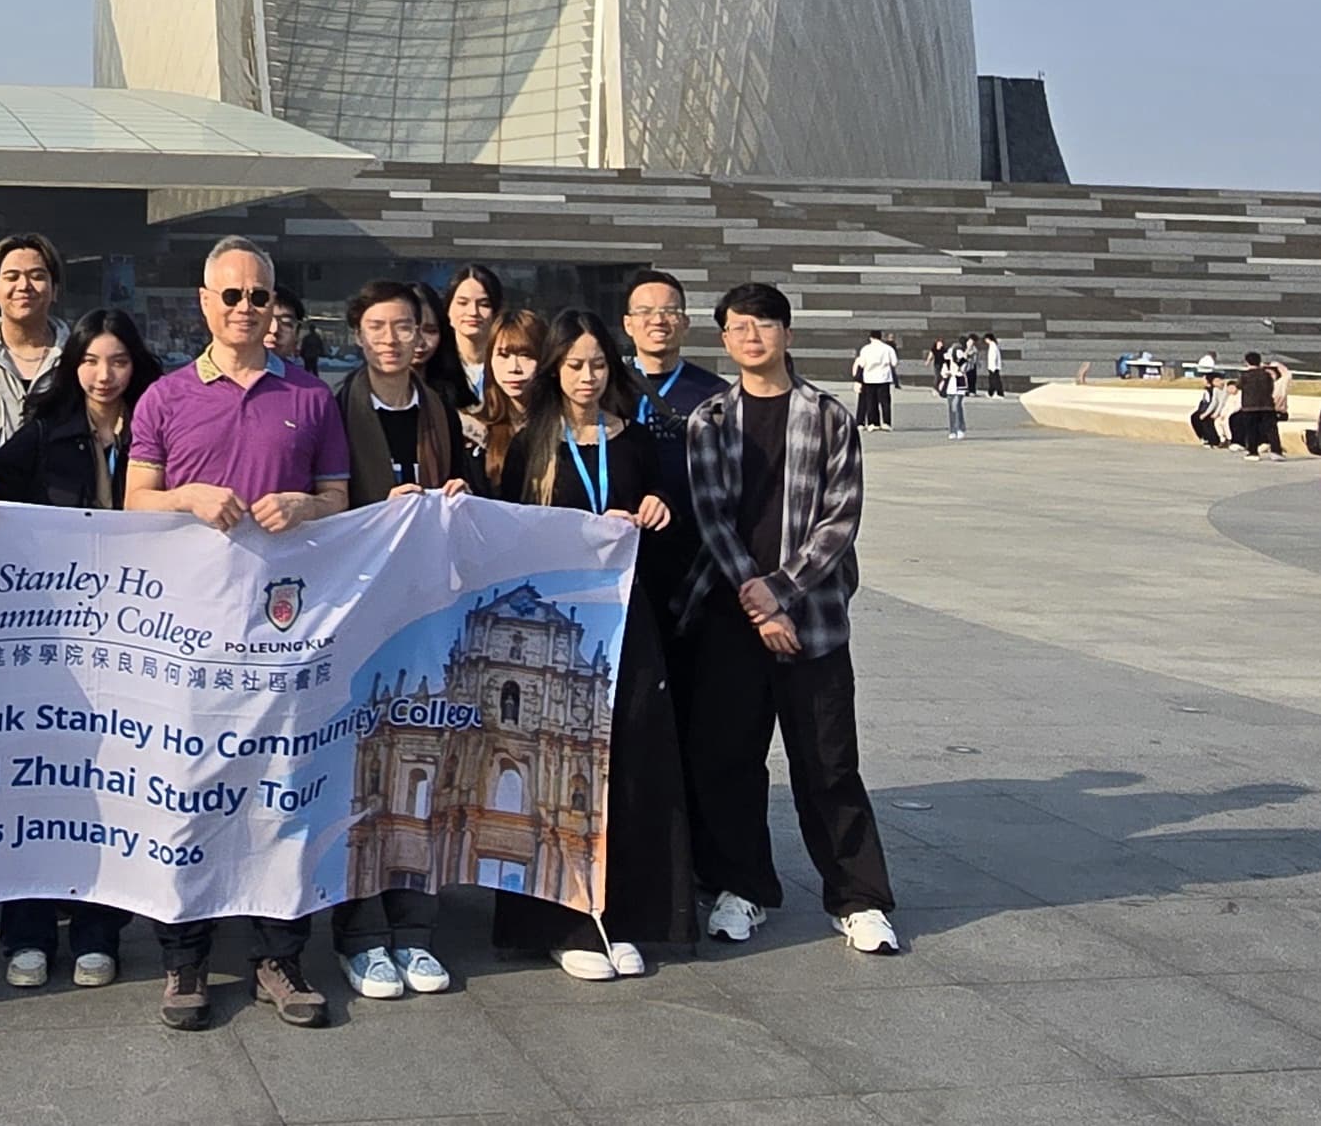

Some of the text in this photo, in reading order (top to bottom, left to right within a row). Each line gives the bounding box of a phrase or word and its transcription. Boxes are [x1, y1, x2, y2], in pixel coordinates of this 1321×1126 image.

[116, 566, 164, 600] Ho
[117, 605, 213, 655] College
[224, 641, 247, 653] PO
[249, 640, 303, 654] LEUNG
[35, 704, 153, 749] Stanley
[163, 724, 205, 756] Ho
[218, 705, 380, 758] Community
[10, 755, 136, 797] Zhuhai
[146, 775, 248, 816] Study
[259, 774, 327, 813] Tour
[11, 815, 139, 857] January
[147, 838, 205, 866] 2026
